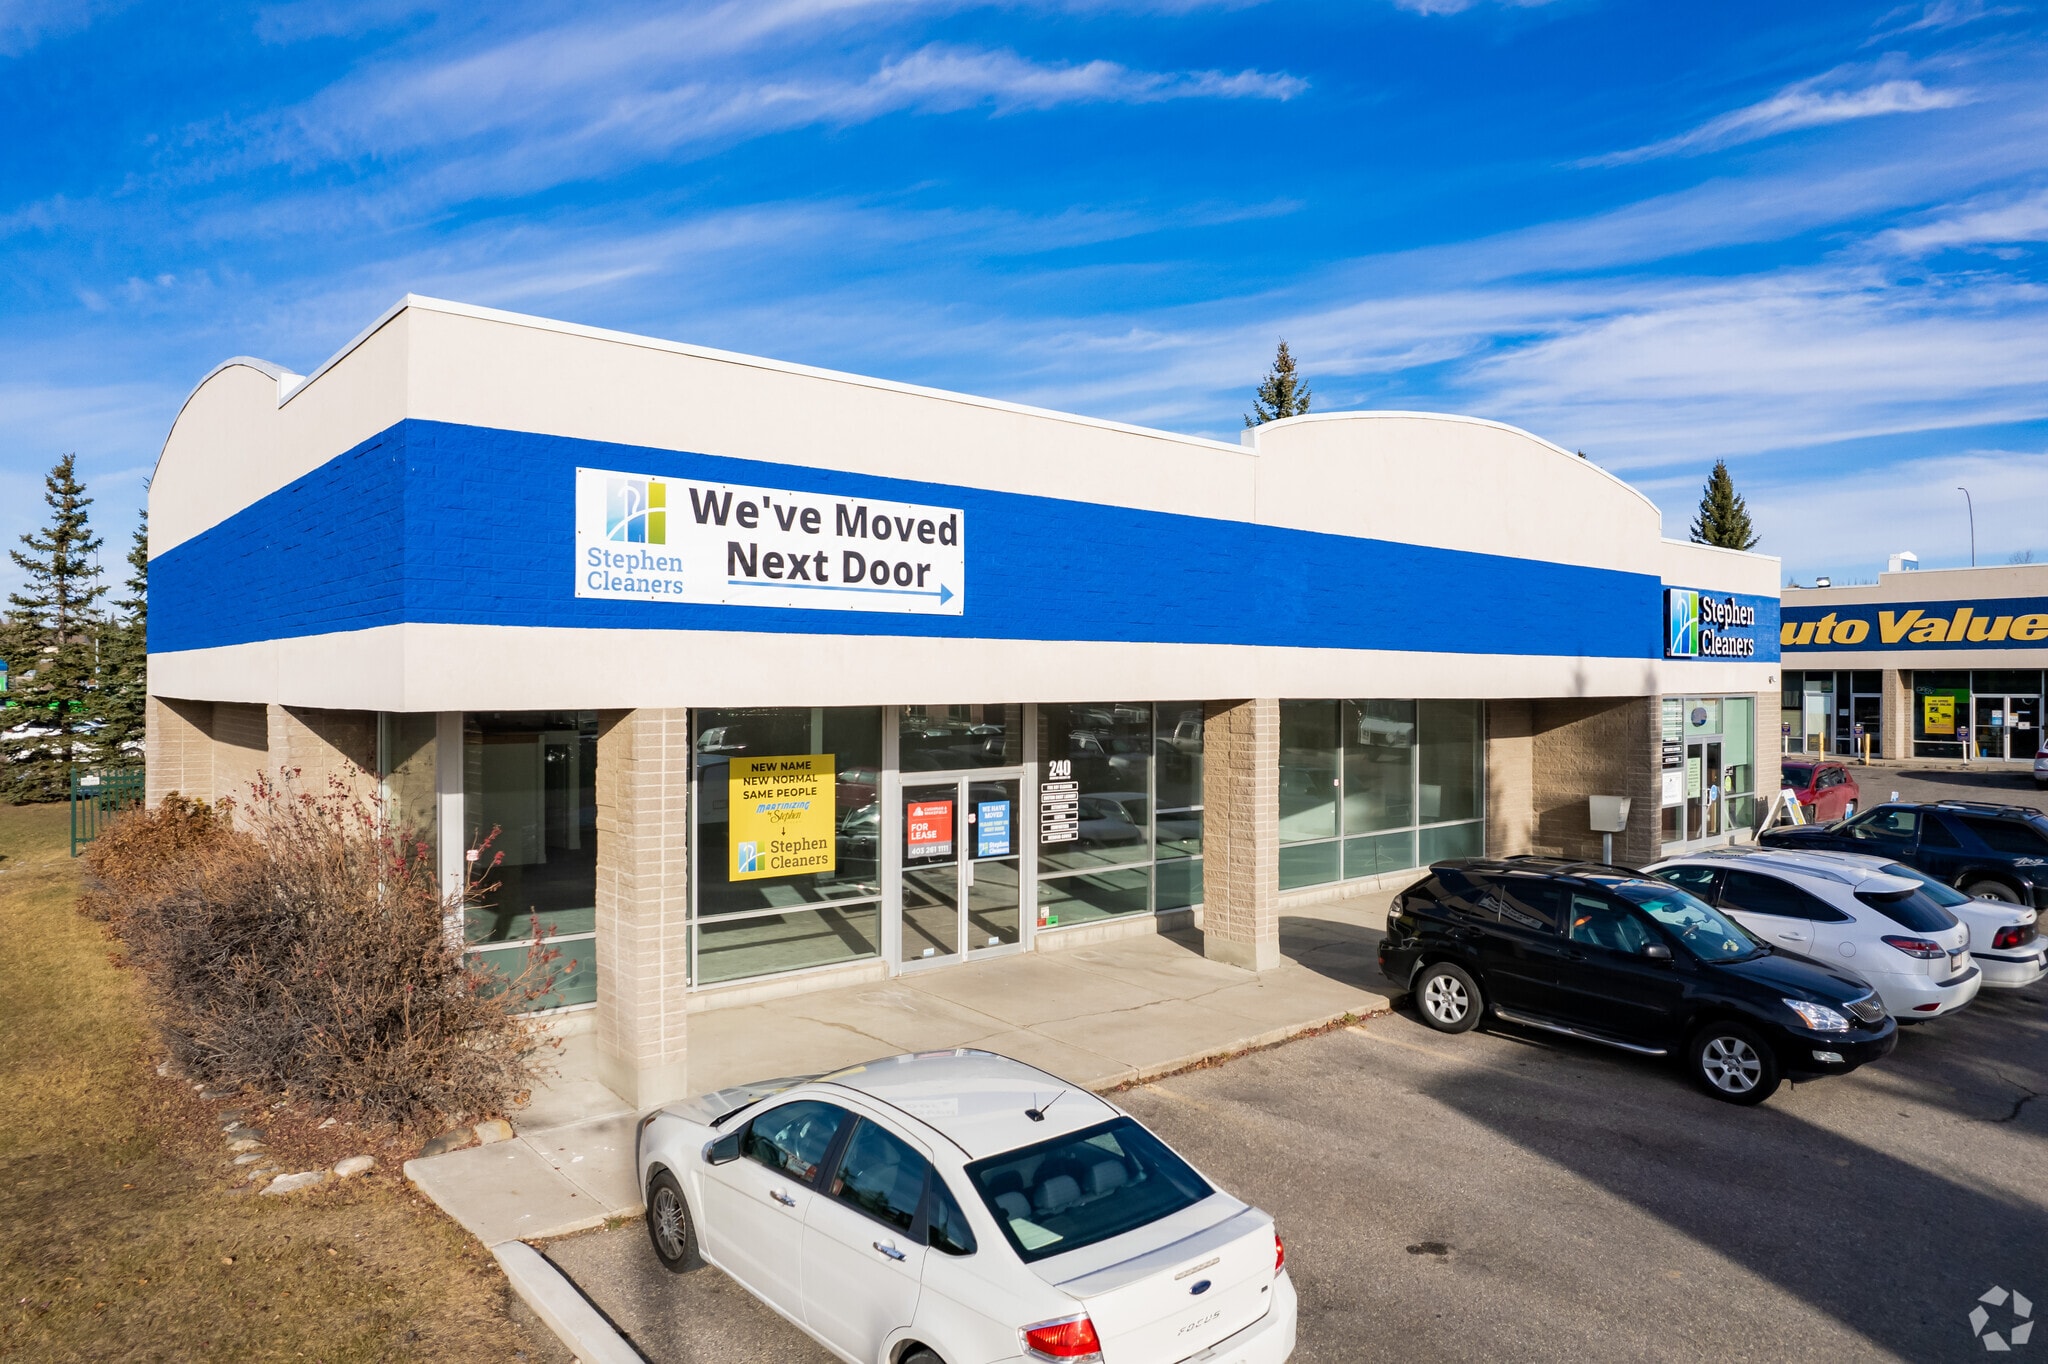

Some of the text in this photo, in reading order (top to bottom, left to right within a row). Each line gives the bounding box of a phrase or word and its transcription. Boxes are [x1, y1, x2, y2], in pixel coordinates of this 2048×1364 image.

[688, 487, 958, 546] We've Moved
[587, 547, 683, 574] Stephen
[727, 541, 931, 588] Next Door
[587, 571, 684, 594] Cleaners
[1703, 596, 1755, 630] Stephen
[1780, 607, 2048, 646] uto Value
[1702, 629, 1754, 656] Cleaners
[751, 761, 811, 772] NEW NAME
[1049, 760, 1071, 777] 240
[743, 774, 818, 786] NEW NORMAL
[743, 787, 817, 800] SAME PEOPLE
[911, 823, 928, 831] FOR
[911, 831, 937, 840] LEASE
[770, 838, 828, 855] Stephen
[911, 847, 924, 855] 403
[770, 854, 828, 870] Cleaners
[1177, 1310, 1221, 1336] FOCUS
